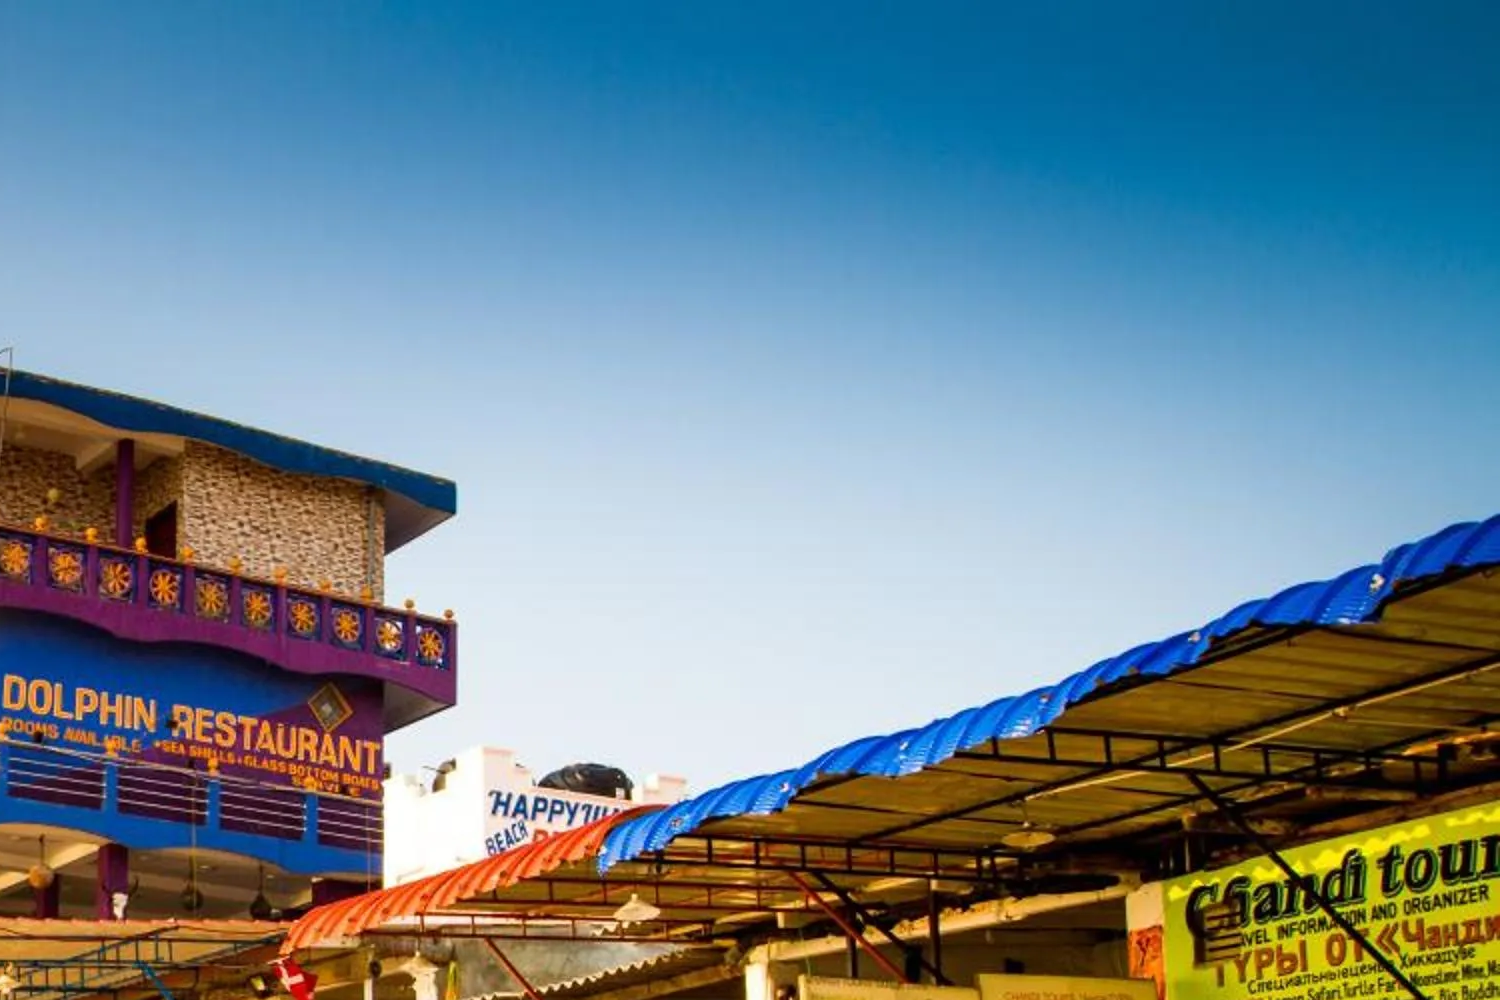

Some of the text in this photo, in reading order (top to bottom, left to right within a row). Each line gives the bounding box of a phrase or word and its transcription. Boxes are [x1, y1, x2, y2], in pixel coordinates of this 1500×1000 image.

[2, 673, 381, 774] DOLPHIN RESTAURANT
[161, 741, 185, 755] SEA
[243, 754, 287, 775] GLASS
[289, 762, 339, 782] BOTTOM
[487, 790, 579, 826] HAPPY
[1277, 909, 1367, 938] INFORMAION
[1370, 902, 1397, 922] AND
[1403, 885, 1490, 915] ORGANIZER
